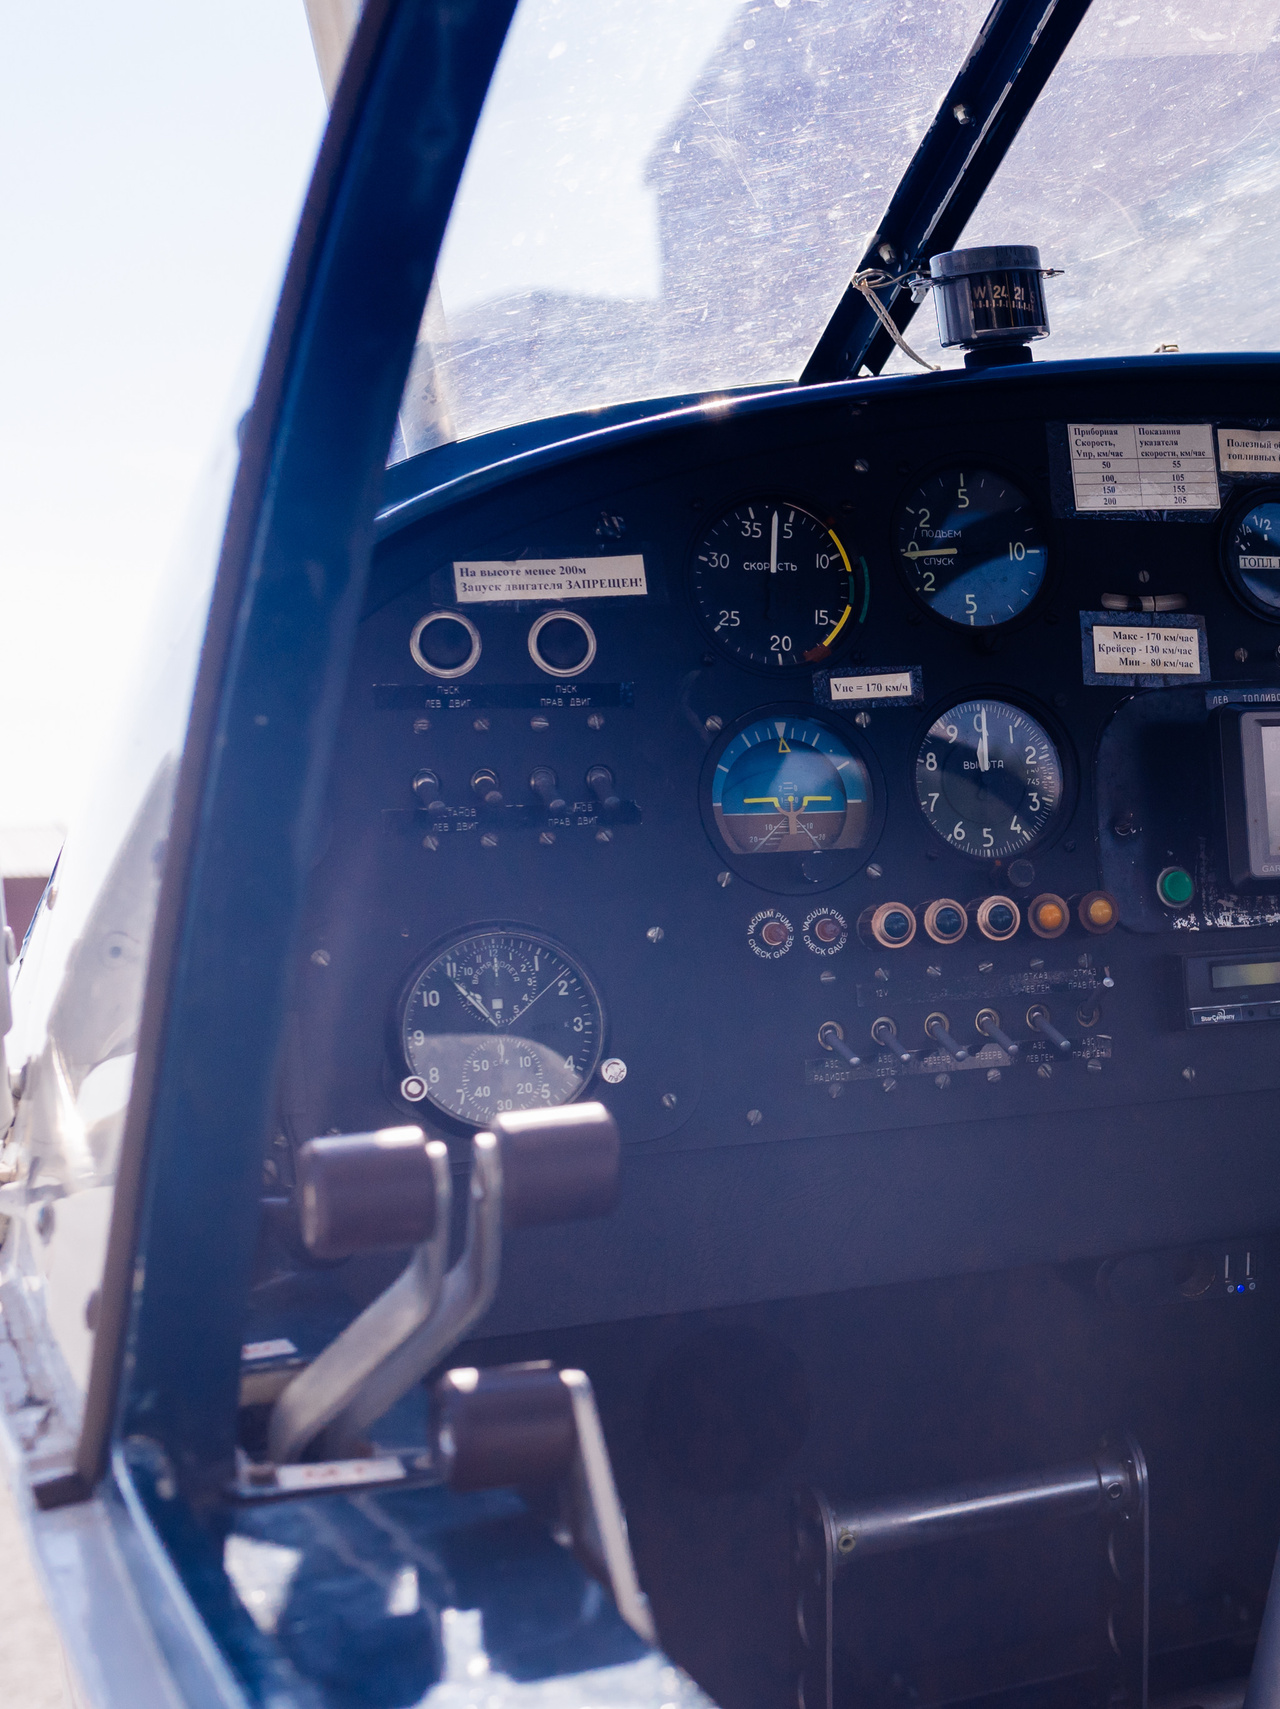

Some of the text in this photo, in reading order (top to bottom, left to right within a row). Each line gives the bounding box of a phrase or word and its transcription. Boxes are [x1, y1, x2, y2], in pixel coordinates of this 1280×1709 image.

[974, 286, 986, 299] W
[993, 285, 1008, 299] 24
[1014, 287, 1024, 300] 21
[1074, 427, 1118, 437] Приборная
[1138, 427, 1181, 436] Показания
[1075, 438, 1115, 448] Скорость,
[1139, 438, 1179, 448] указателя
[1227, 439, 1271, 450] Полезный
[1097, 450, 1123, 458] км/час
[1141, 449, 1206, 459] скорости, км/час
[1227, 452, 1276, 463] топливных
[1102, 461, 1111, 469] 50
[1172, 460, 1182, 468] 55
[1101, 474, 1115, 482] 100
[1172, 474, 1185, 482] 105
[1102, 486, 1115, 494] 150
[1173, 485, 1186, 494] 155
[958, 489, 969, 508] 5
[1103, 497, 1117, 506] 200
[1174, 496, 1187, 504] 205
[918, 508, 930, 527] 2
[1253, 515, 1272, 531] 1/2
[741, 520, 762, 538] 35
[783, 523, 793, 539] 5
[1009, 542, 1025, 561] 10
[708, 552, 730, 569] 30
[743, 562, 797, 571] СКОРСТЬ
[816, 553, 830, 569] 10
[923, 557, 954, 566] СПУСК
[1241, 557, 1276, 568] ТОПЛ.
[459, 565, 587, 577] На высоте менее 200м
[460, 577, 643, 594] Запуск двигателя ЗАПРЕЩЕН!
[923, 572, 936, 591] 2
[965, 594, 977, 614] 5
[719, 610, 740, 627] 25
[815, 610, 829, 625] 15
[770, 635, 792, 651] 20
[1113, 631, 1194, 643] Макс 170 км/час
[1098, 643, 1192, 655] Крейсер 130 км/час
[1119, 657, 1194, 668] Мин 80 км/час
[436, 686, 460, 695] ПУСК
[555, 685, 578, 694] ПУСК
[866, 683, 882, 692] 170
[885, 683, 908, 692] км/ч
[425, 699, 472, 708] ЛЕВ ДВИГ
[540, 698, 591, 707] ПРАВ ДВИГ
[1212, 696, 1229, 705] ЛЕВ
[946, 725, 958, 743] 9
[1009, 725, 1014, 743] 1
[925, 752, 937, 771] 8
[1024, 746, 1037, 765] 2
[1027, 777, 1040, 786] 745
[928, 793, 939, 812] 7
[1028, 792, 1040, 812] 3
[432, 822, 479, 832] ЛЕВ ДВИГ
[577, 816, 599, 825] ДВИГ
[1010, 815, 1022, 834] 4
[953, 821, 966, 841] 6
[983, 828, 994, 847] 5
[747, 910, 794, 935] VACUUM PUMP
[802, 907, 848, 932] VACUUM PUMP
[748, 935, 794, 959] CHECK GAUGE
[803, 932, 848, 956] CHECK GAUGE
[472, 961, 492, 985] ВРЕМЯ
[558, 980, 569, 996] 2
[422, 991, 440, 1007] 10
[573, 1017, 583, 1033] 3
[413, 1030, 424, 1046] 9
[472, 1060, 489, 1071] 50
[519, 1057, 532, 1068] 10
[564, 1055, 575, 1072] 4
[429, 1067, 440, 1083] 8
[474, 1086, 491, 1098] 40
[517, 1083, 533, 1095] 20
[541, 1083, 550, 1099] 5
[456, 1089, 466, 1105] 7
[497, 1100, 513, 1111] 30
